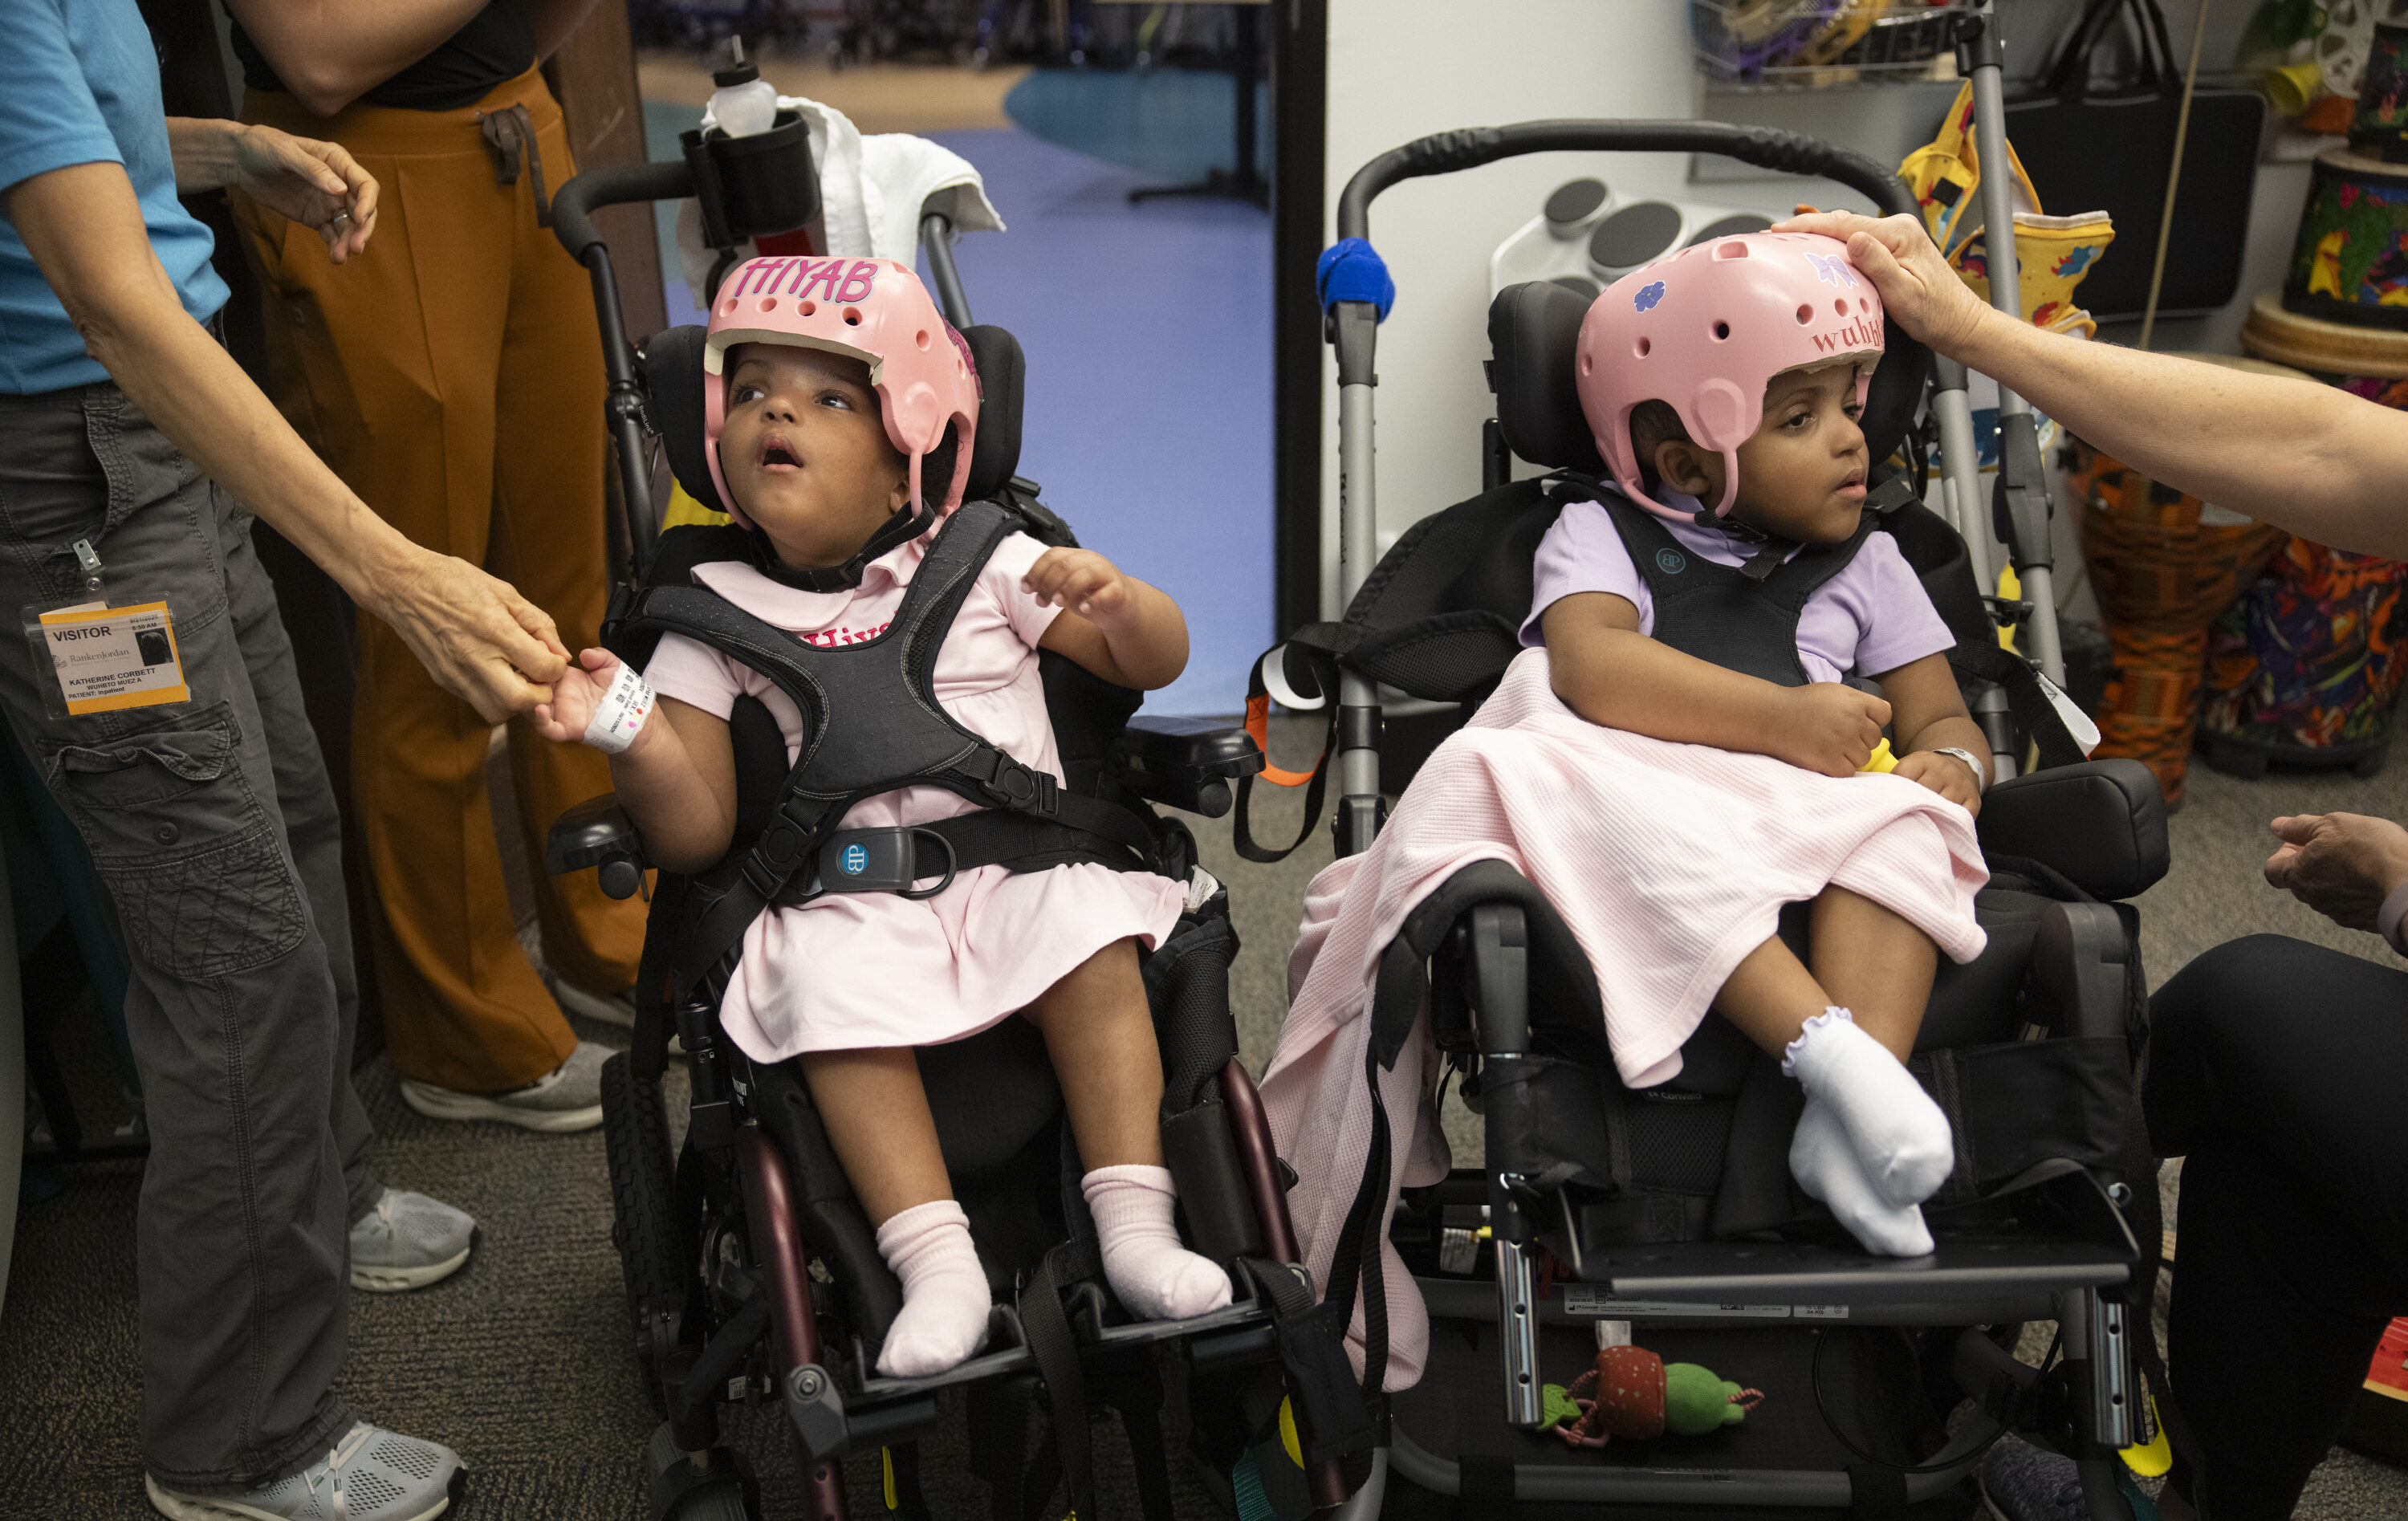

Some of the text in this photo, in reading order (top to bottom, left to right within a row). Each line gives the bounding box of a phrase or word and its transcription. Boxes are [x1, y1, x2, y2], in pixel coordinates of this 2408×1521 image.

[734, 258, 879, 303] HIYAB
[1811, 315, 1884, 352] wuhbt
[53, 626, 112, 642] VISITOR
[70, 649, 129, 663] RankenJordan
[69, 668, 157, 686] KATHERINE CORBETT
[68, 686, 125, 699] PATIENT: Inpatient
[87, 681, 116, 690] WUHBTO
